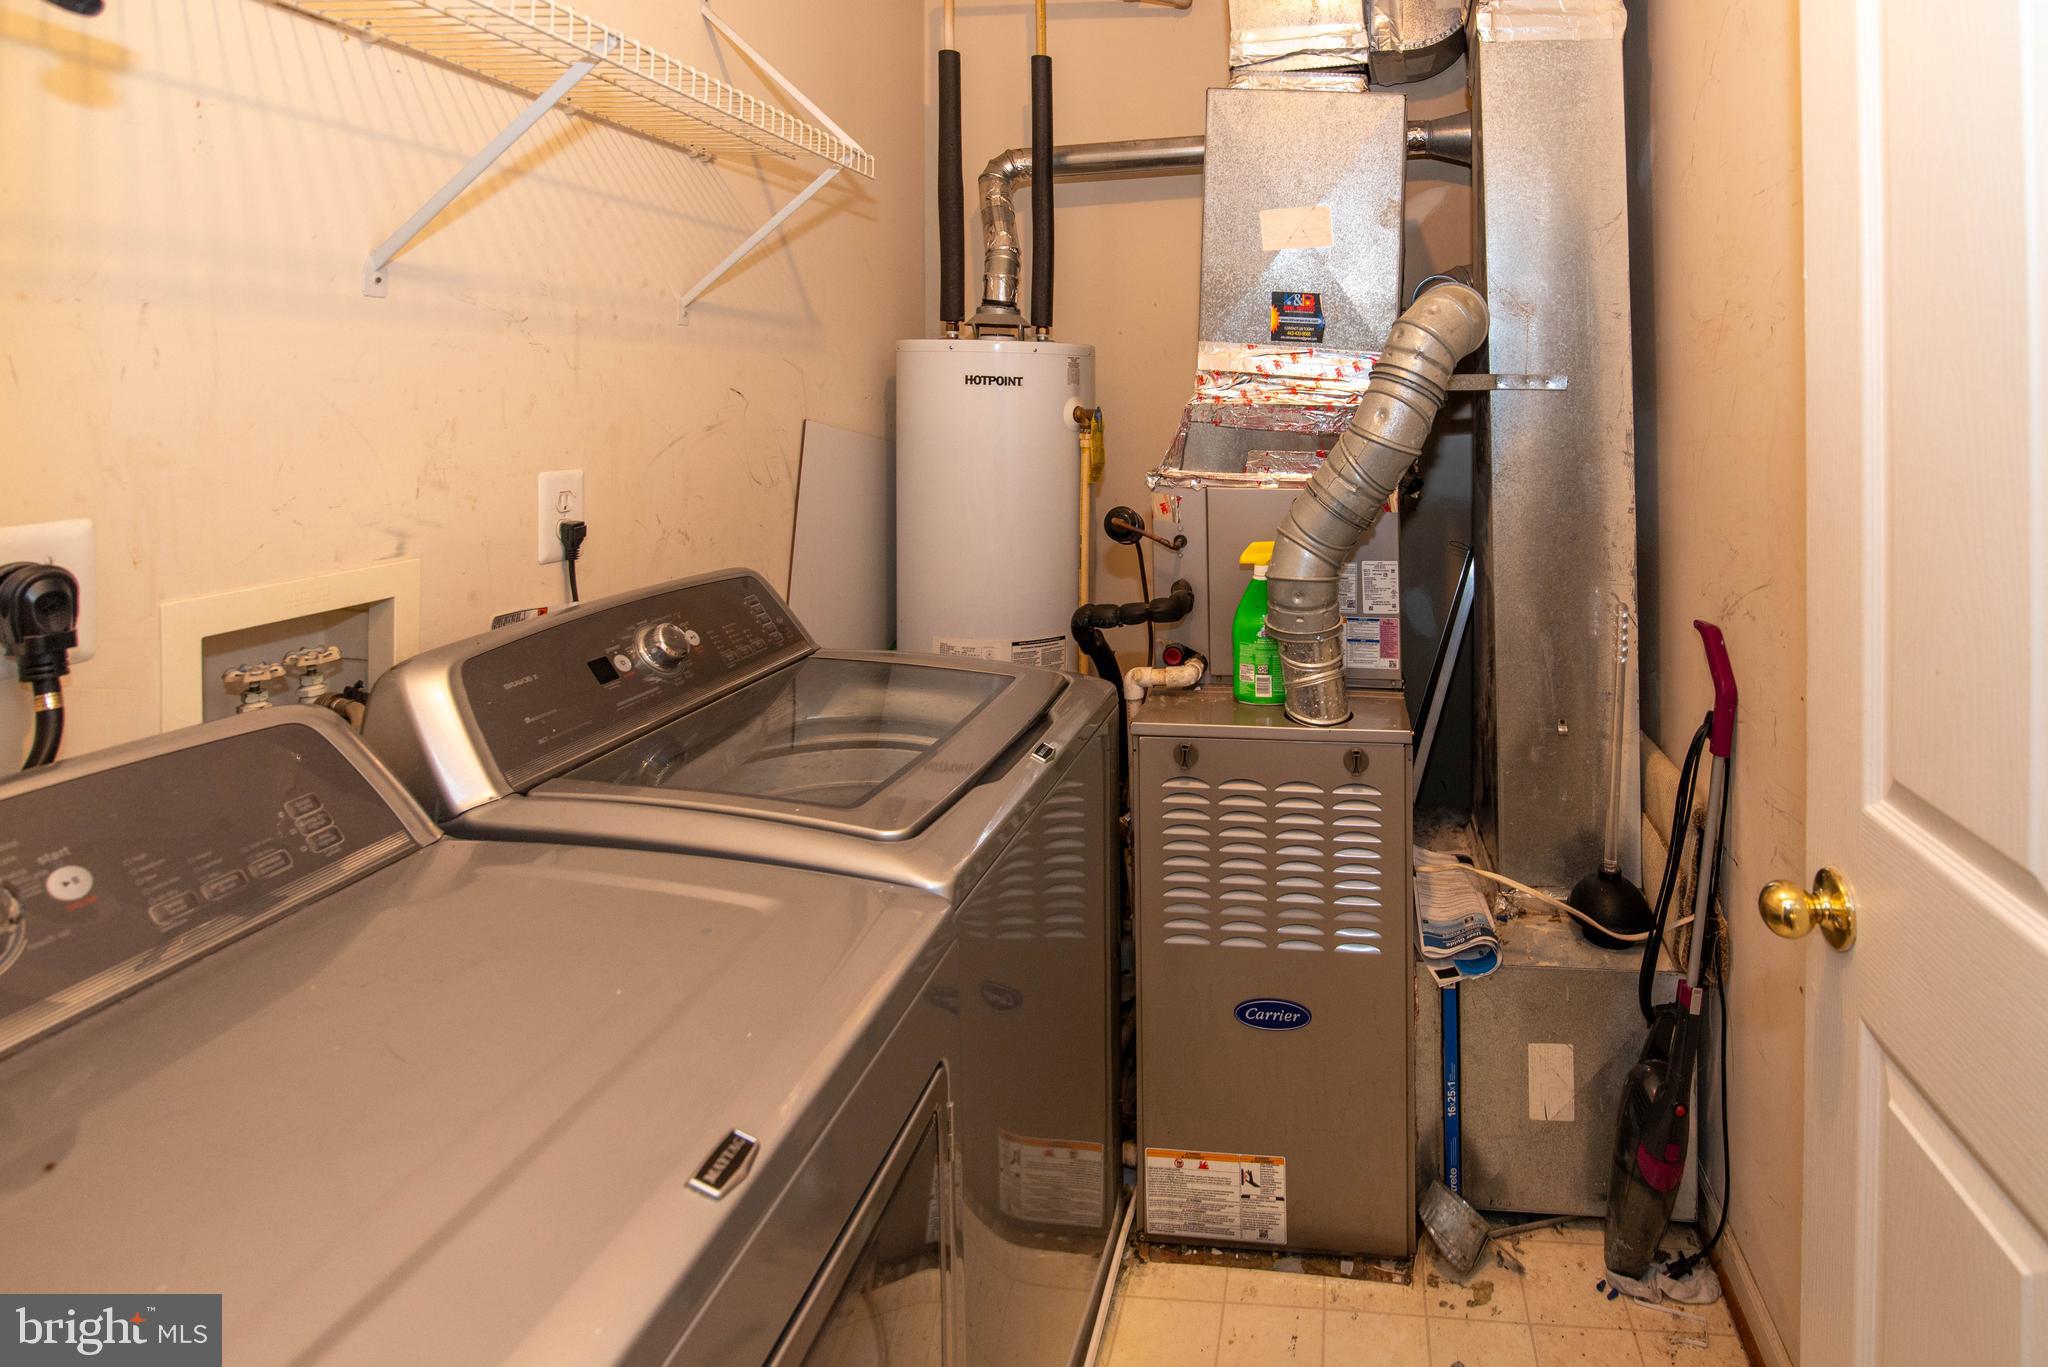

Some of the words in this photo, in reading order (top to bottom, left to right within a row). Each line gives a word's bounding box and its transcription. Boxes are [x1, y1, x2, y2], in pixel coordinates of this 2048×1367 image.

[964, 374, 1024, 388] HOTPOINT
[1245, 1007, 1301, 1022] Carrier
[1447, 1081, 1456, 1117] 16x25x1
